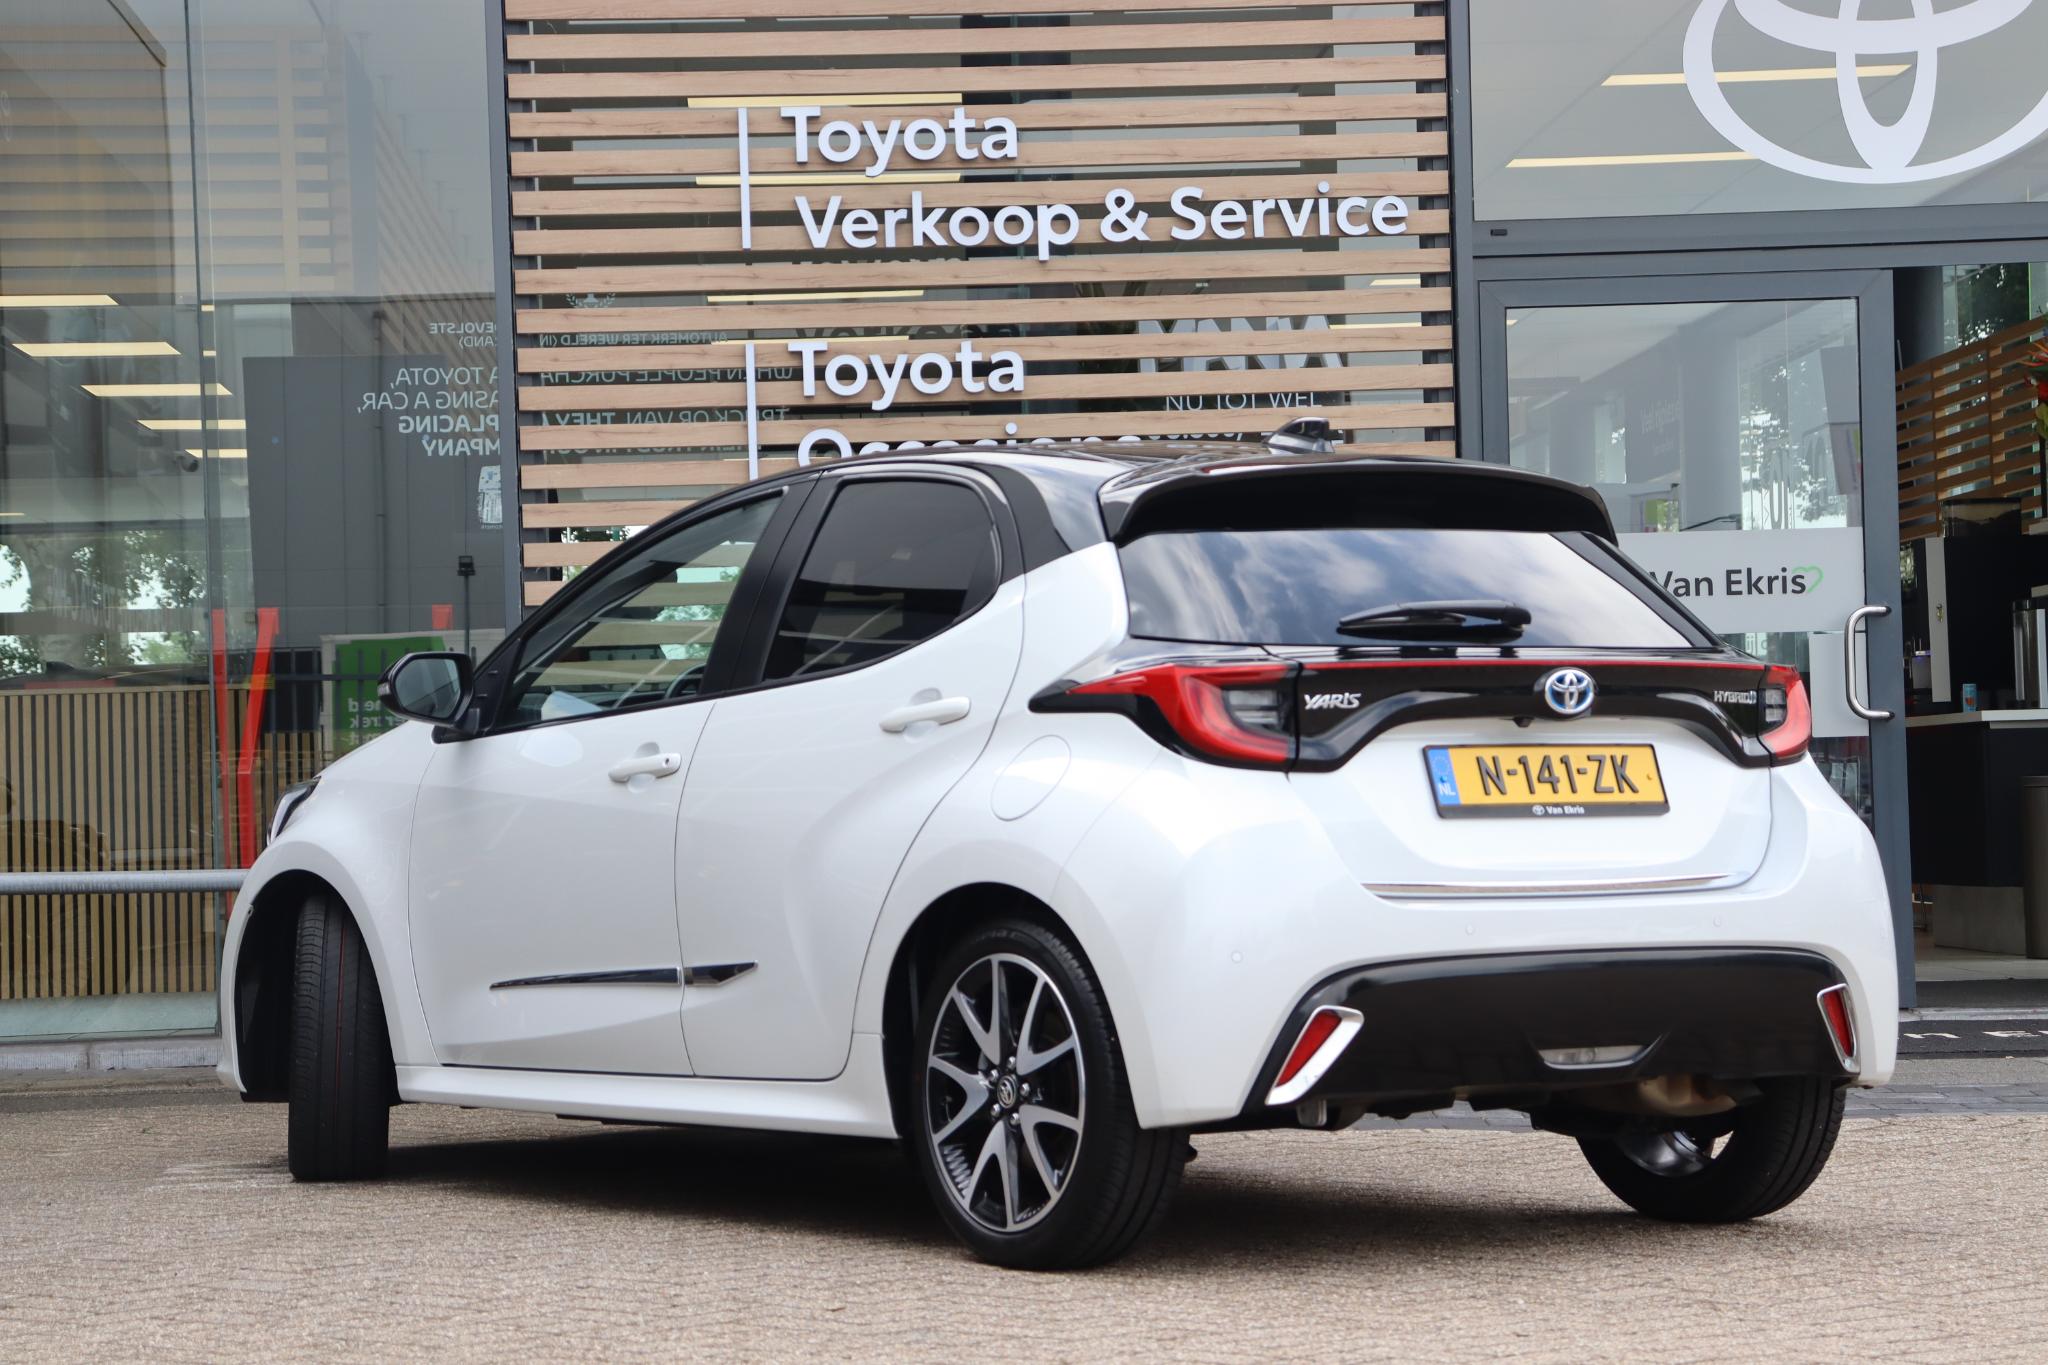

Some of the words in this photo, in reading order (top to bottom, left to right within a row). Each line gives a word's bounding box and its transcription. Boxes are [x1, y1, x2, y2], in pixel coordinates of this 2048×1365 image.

[780, 106, 1019, 178] Toyota
[794, 191, 1080, 261] Verkoop
[1100, 187, 1149, 241] &
[1170, 180, 1408, 241] Service
[787, 340, 1025, 411] Toyota
[1726, 567, 1806, 596] Ekris
[1304, 692, 1361, 710] YARIS
[1714, 691, 1750, 703] HYBRID
[1476, 755, 1639, 796] N-141-ZK
[1439, 785, 1456, 796] NL
[1547, 805, 1563, 815] Van
[1565, 804, 1584, 815] Ekris
